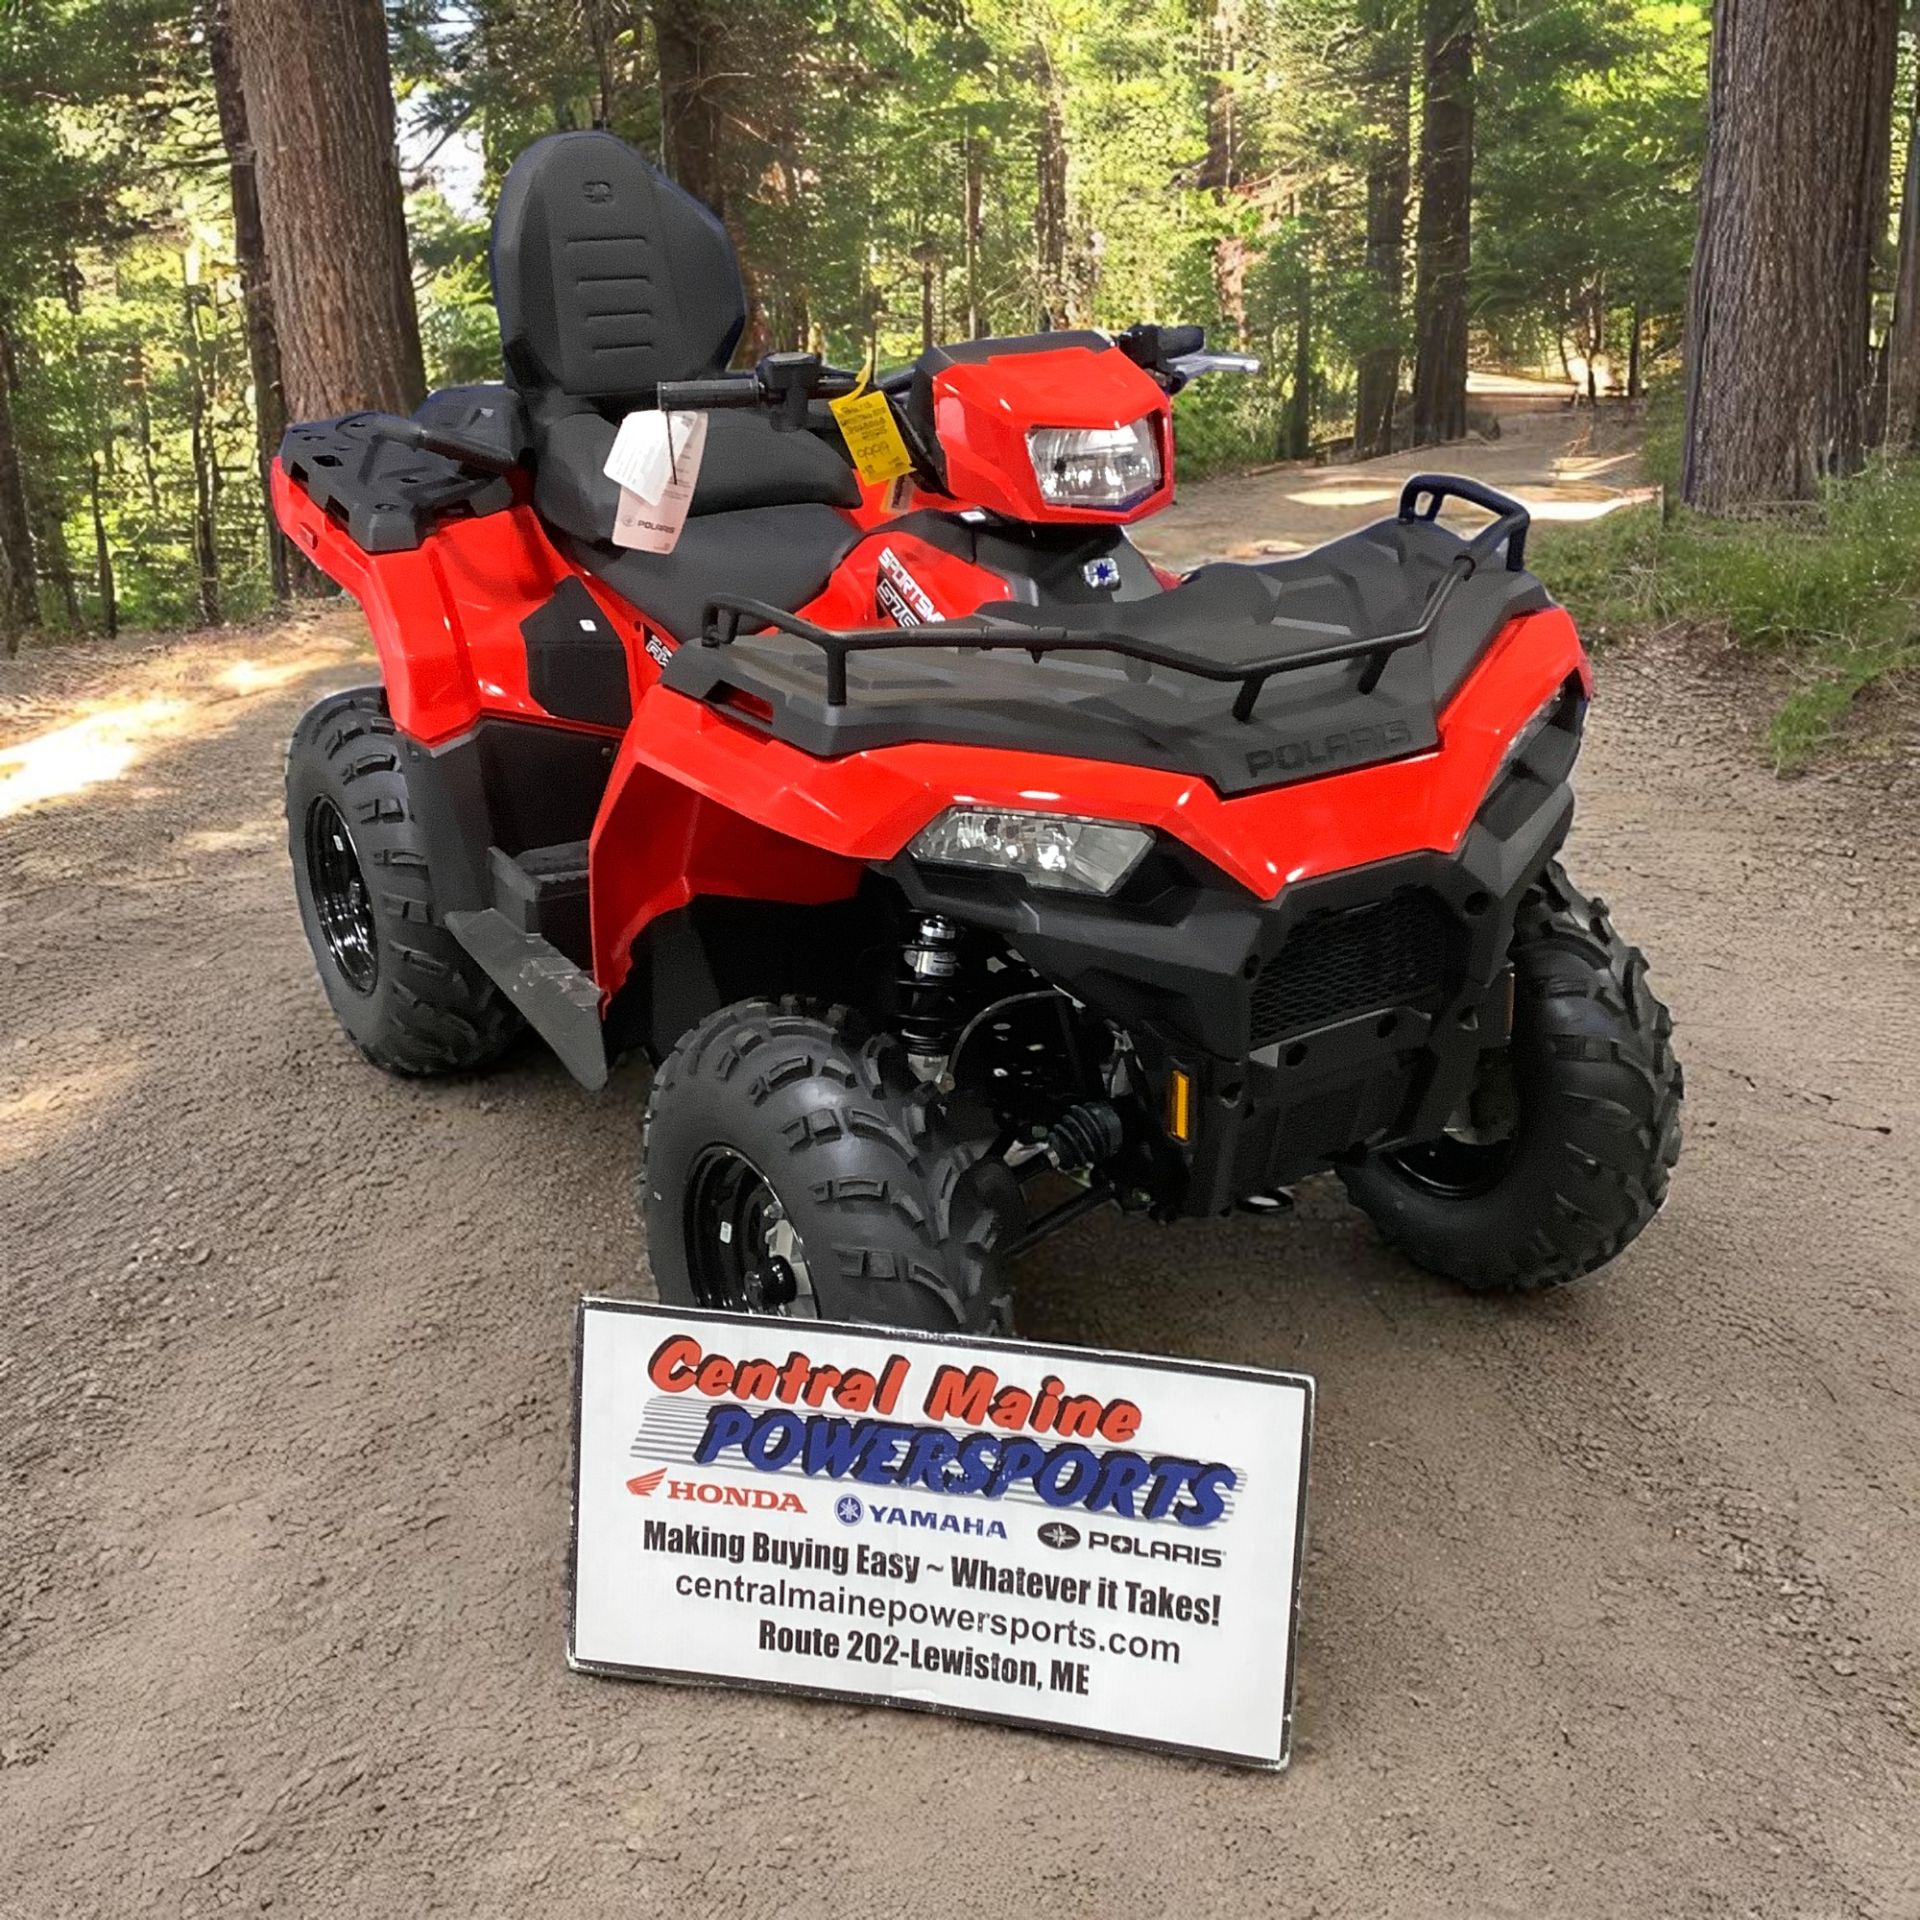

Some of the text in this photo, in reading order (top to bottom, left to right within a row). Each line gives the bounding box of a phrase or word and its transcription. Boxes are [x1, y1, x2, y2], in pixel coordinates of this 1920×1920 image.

[647, 1334, 1142, 1443] Central Maine
[667, 1480, 808, 1514] HONDA
[692, 1403, 1238, 1529] POWERSPORTS
[868, 1504, 1008, 1540] YAMAHA
[1088, 1531, 1223, 1568] POLARIS
[643, 1519, 745, 1564] Making
[752, 1531, 849, 1576] Buying
[856, 1543, 921, 1584] Easy
[950, 1555, 1092, 1606] Whatever
[1097, 1576, 1119, 1611] it
[1124, 1580, 1221, 1627] Takes!
[675, 1574, 1181, 1664] centralmainepowersports.com
[758, 1619, 1090, 1696] Route 202-Lewiston, ME
